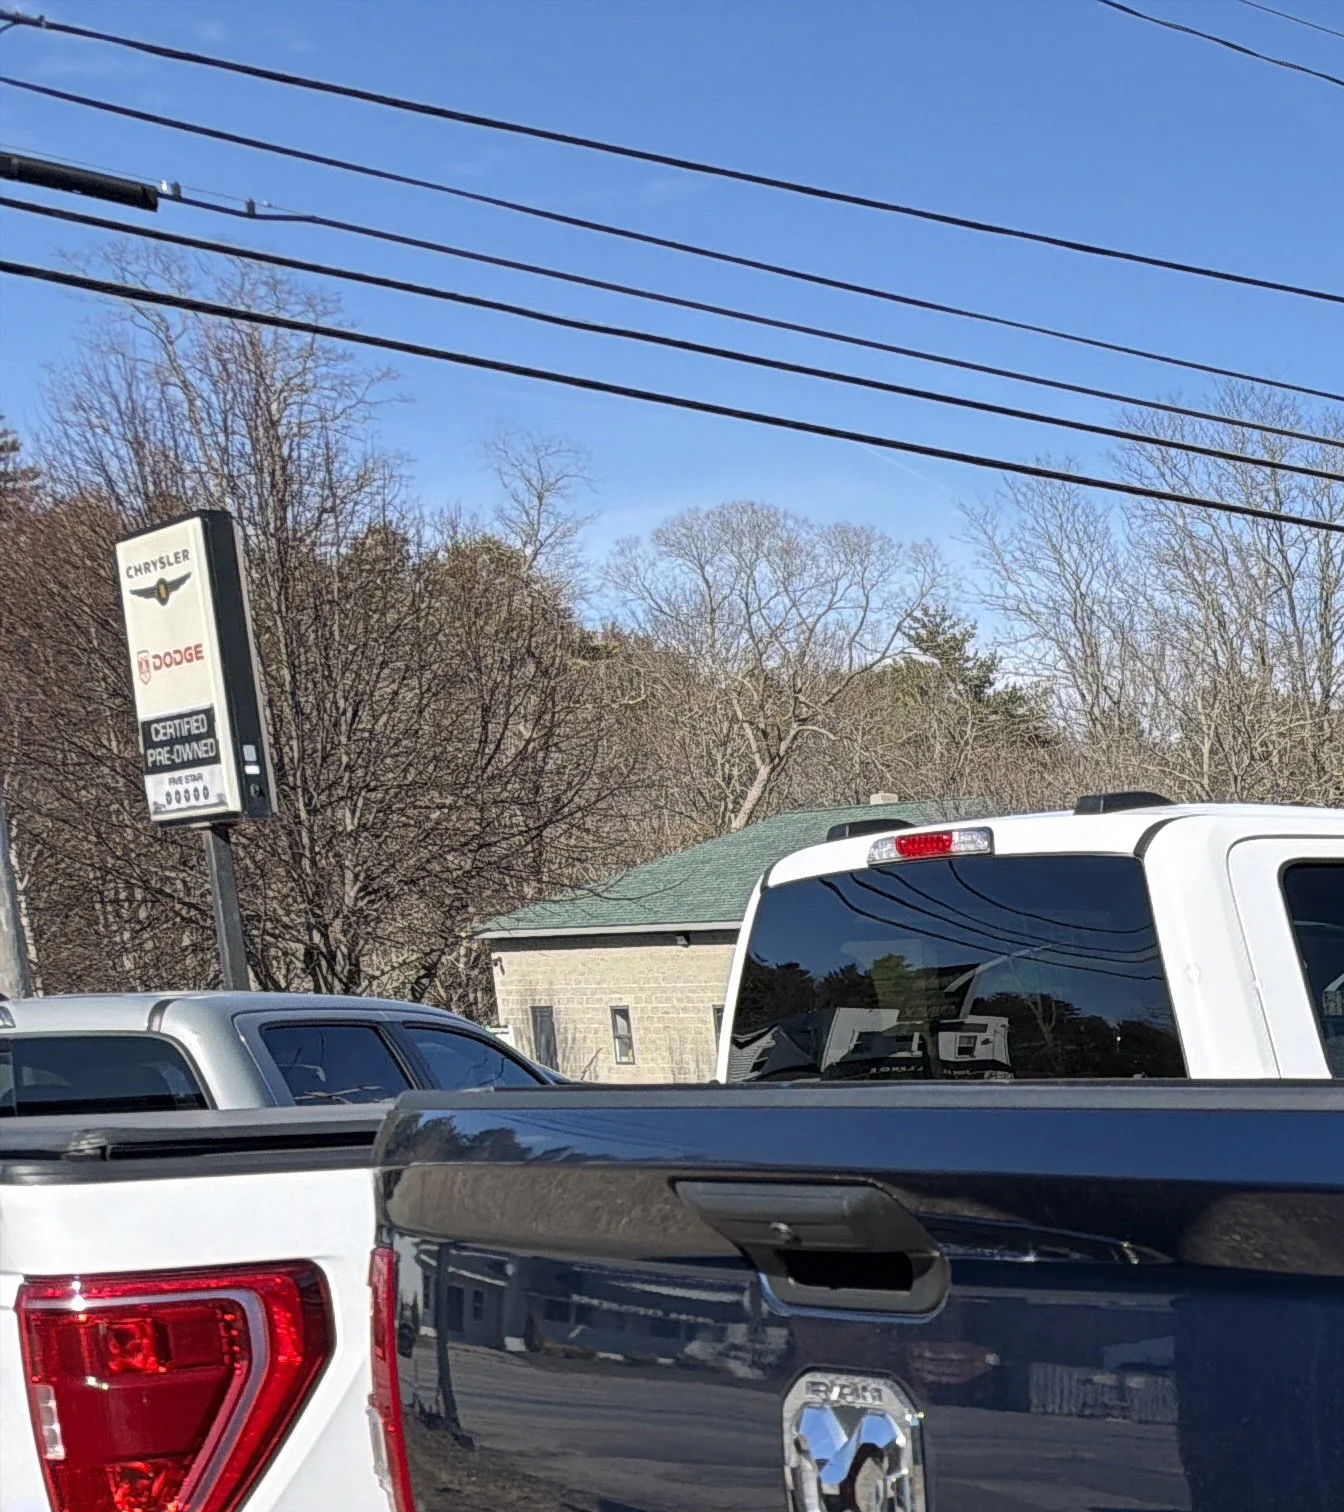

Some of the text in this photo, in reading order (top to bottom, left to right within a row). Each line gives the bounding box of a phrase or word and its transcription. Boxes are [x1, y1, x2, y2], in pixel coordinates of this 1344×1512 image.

[126, 549, 190, 579] CHRYSLER
[152, 643, 204, 671] DODGE
[151, 714, 207, 742] CERTIFIED
[147, 738, 216, 767] PRE-OWNED
[805, 1380, 884, 1405] RAM
